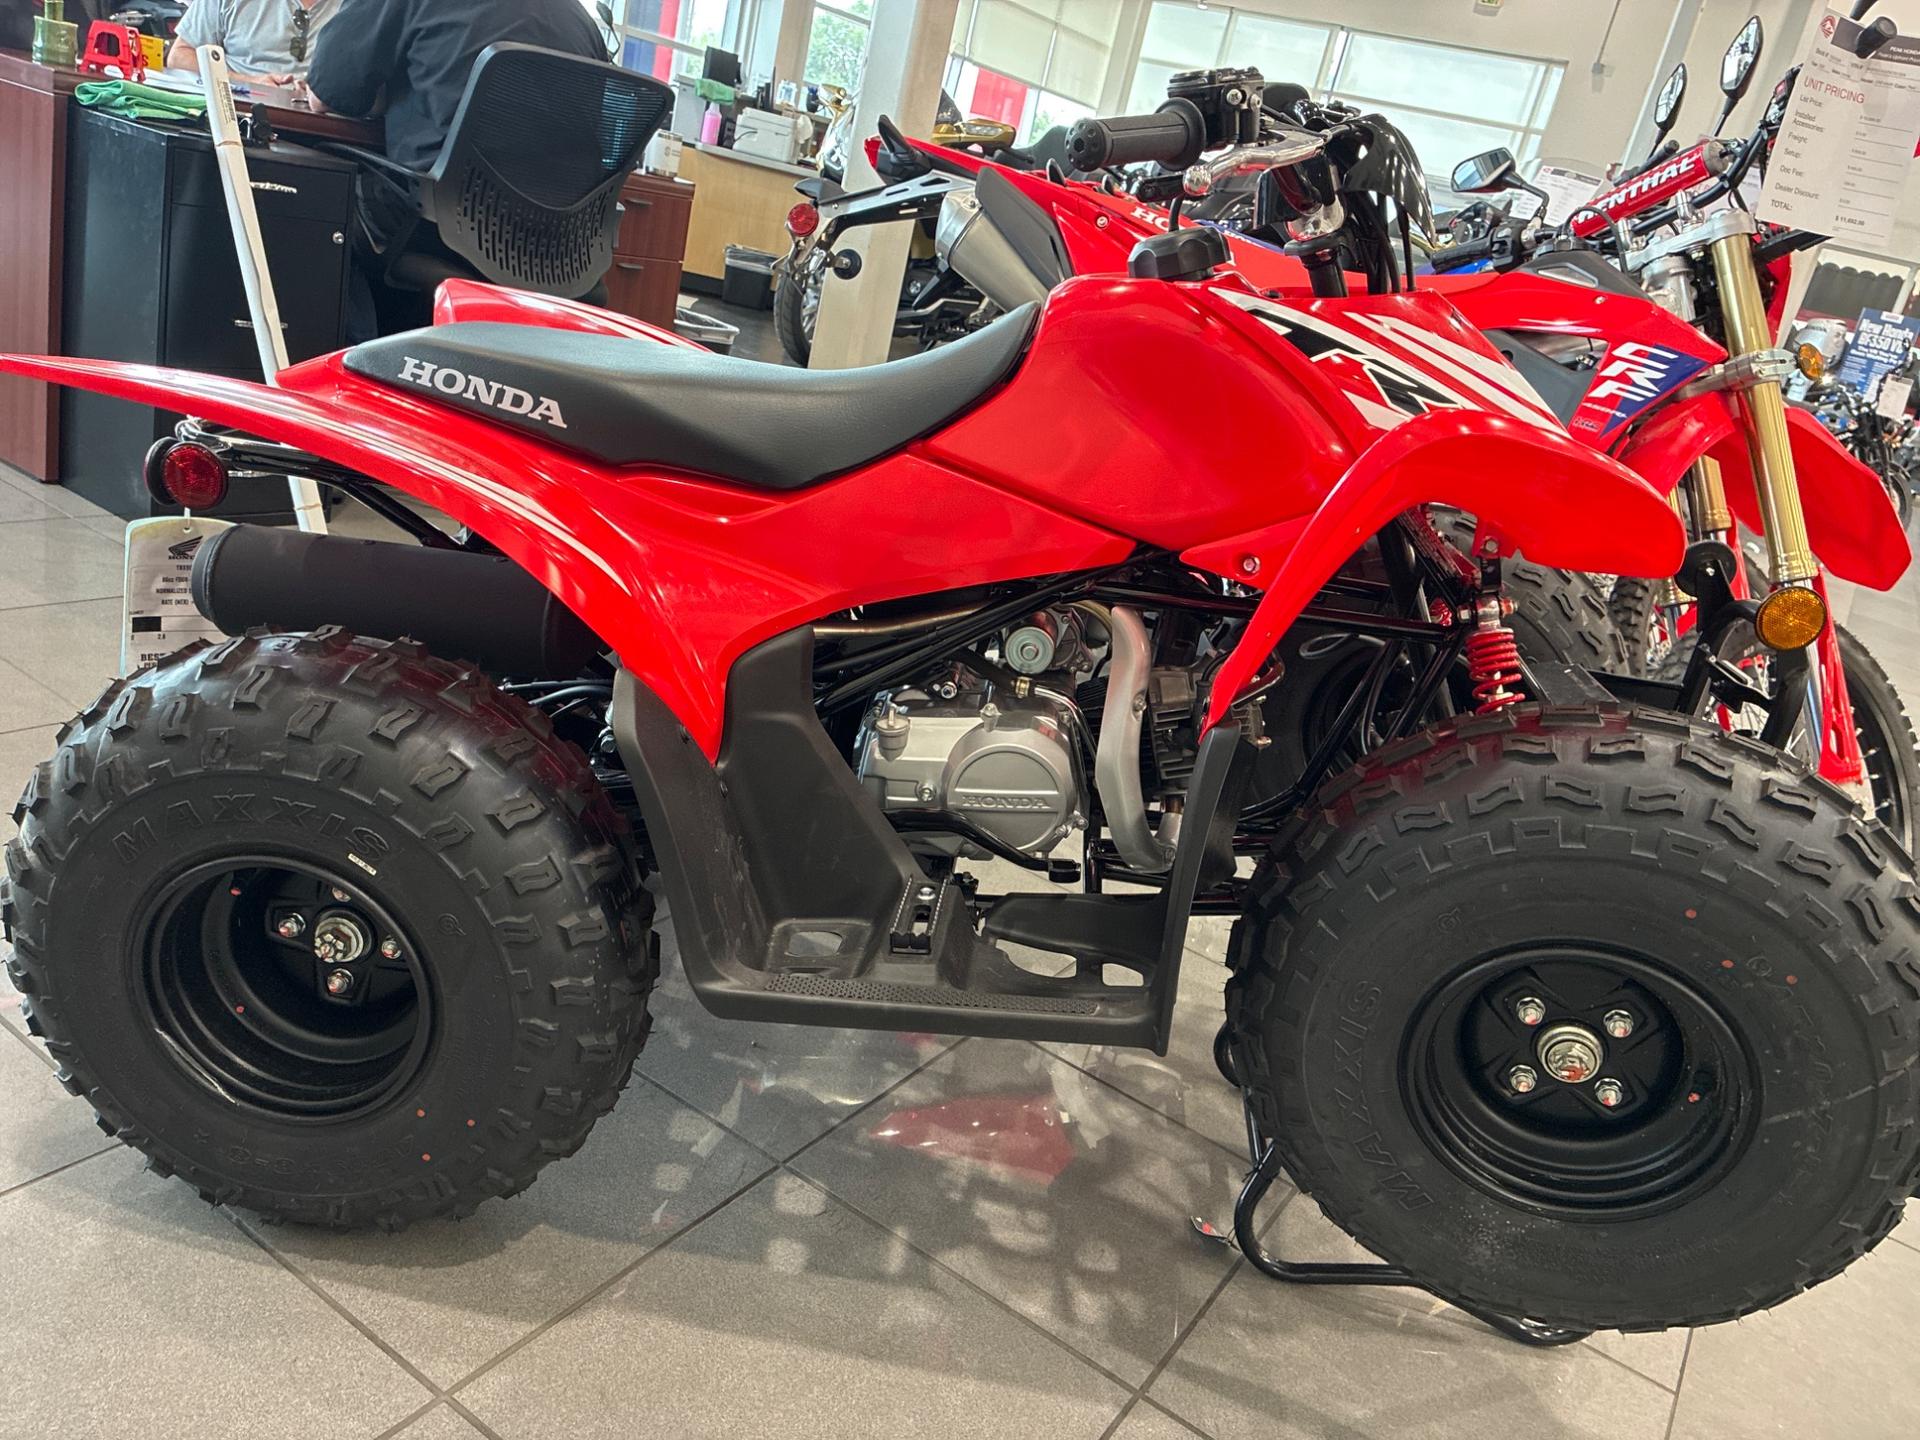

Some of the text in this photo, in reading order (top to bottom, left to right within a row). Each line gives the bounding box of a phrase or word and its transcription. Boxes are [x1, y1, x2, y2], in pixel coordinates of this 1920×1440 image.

[1804, 77, 1865, 104] UNIT PRICING
[1774, 182, 1794, 195] Dealer
[1771, 199, 1793, 211] TOTAL:
[1860, 319, 1882, 333] New
[1587, 341, 1680, 402] CRF
[397, 356, 568, 429] HONDA
[962, 795, 1049, 809] HONDA
[112, 793, 391, 862] MAXXIS
[1331, 980, 1433, 1211] MAXXIS
